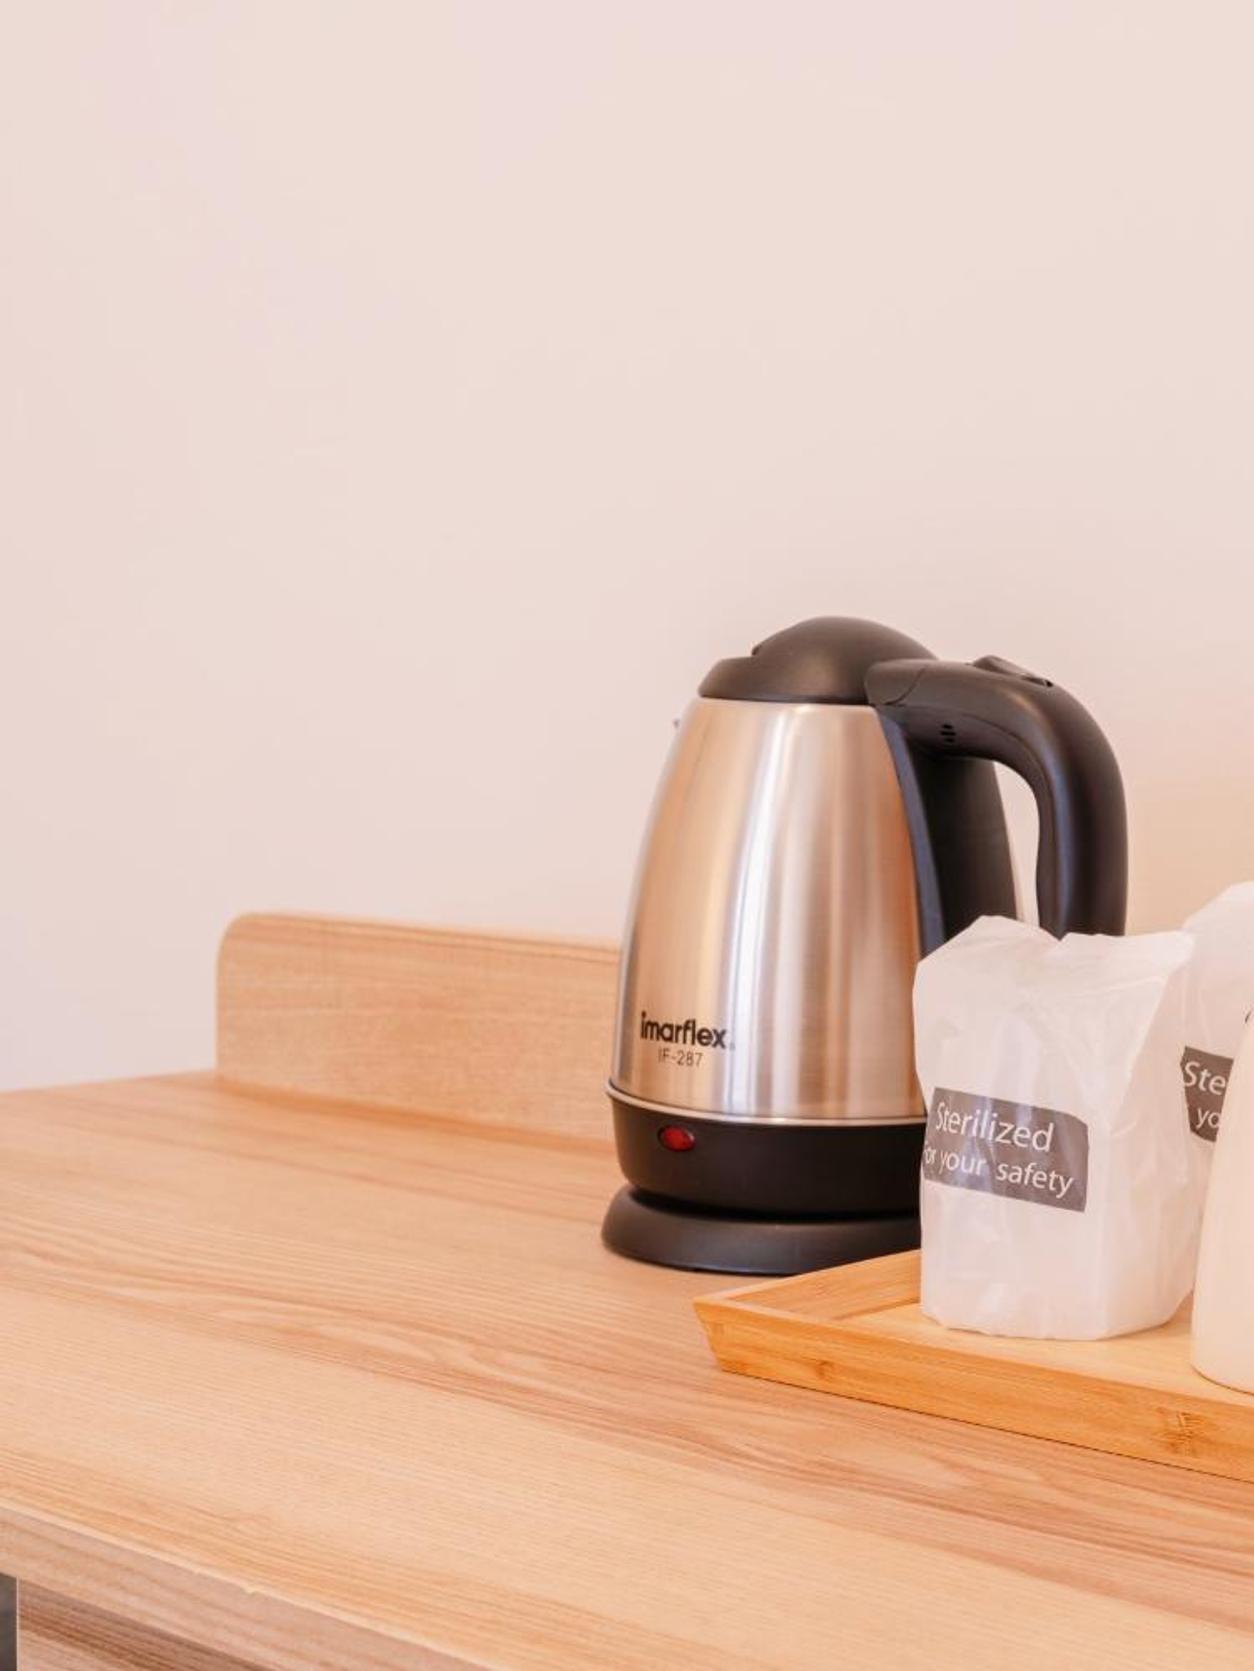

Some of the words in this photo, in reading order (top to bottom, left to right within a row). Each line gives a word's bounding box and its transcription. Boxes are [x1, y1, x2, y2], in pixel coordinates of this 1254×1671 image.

[640, 1010, 726, 1049] imarflex
[657, 1047, 703, 1067] IF-287
[935, 1101, 1055, 1153] Sterilized
[939, 1149, 987, 1176] your
[995, 1161, 1076, 1199] safety
